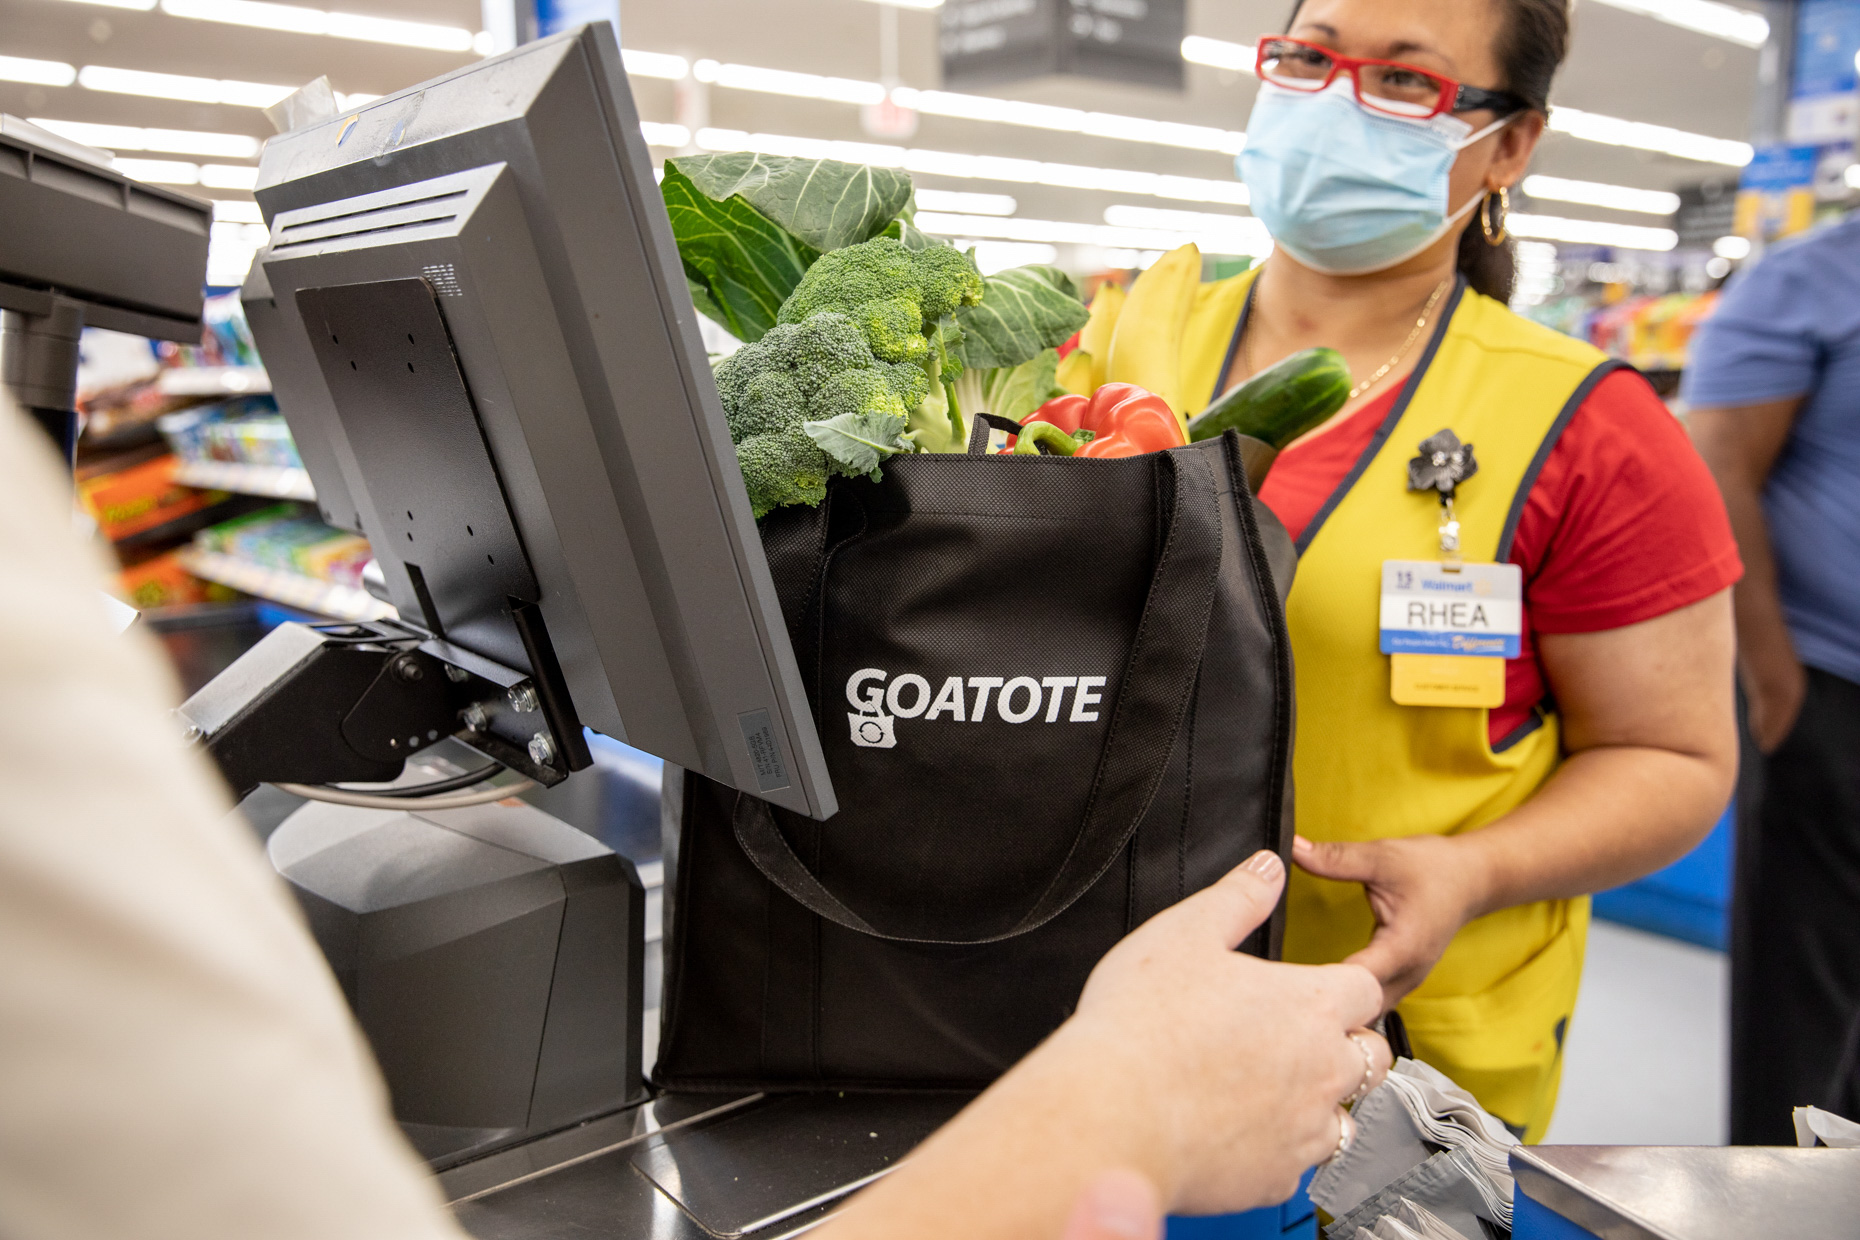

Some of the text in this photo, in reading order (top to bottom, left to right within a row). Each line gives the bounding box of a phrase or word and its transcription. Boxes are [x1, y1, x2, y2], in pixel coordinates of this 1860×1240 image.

[1421, 580, 1474, 592] Walmart
[1407, 602, 1489, 628] RHEA
[846, 668, 1107, 724] GOATOTE
